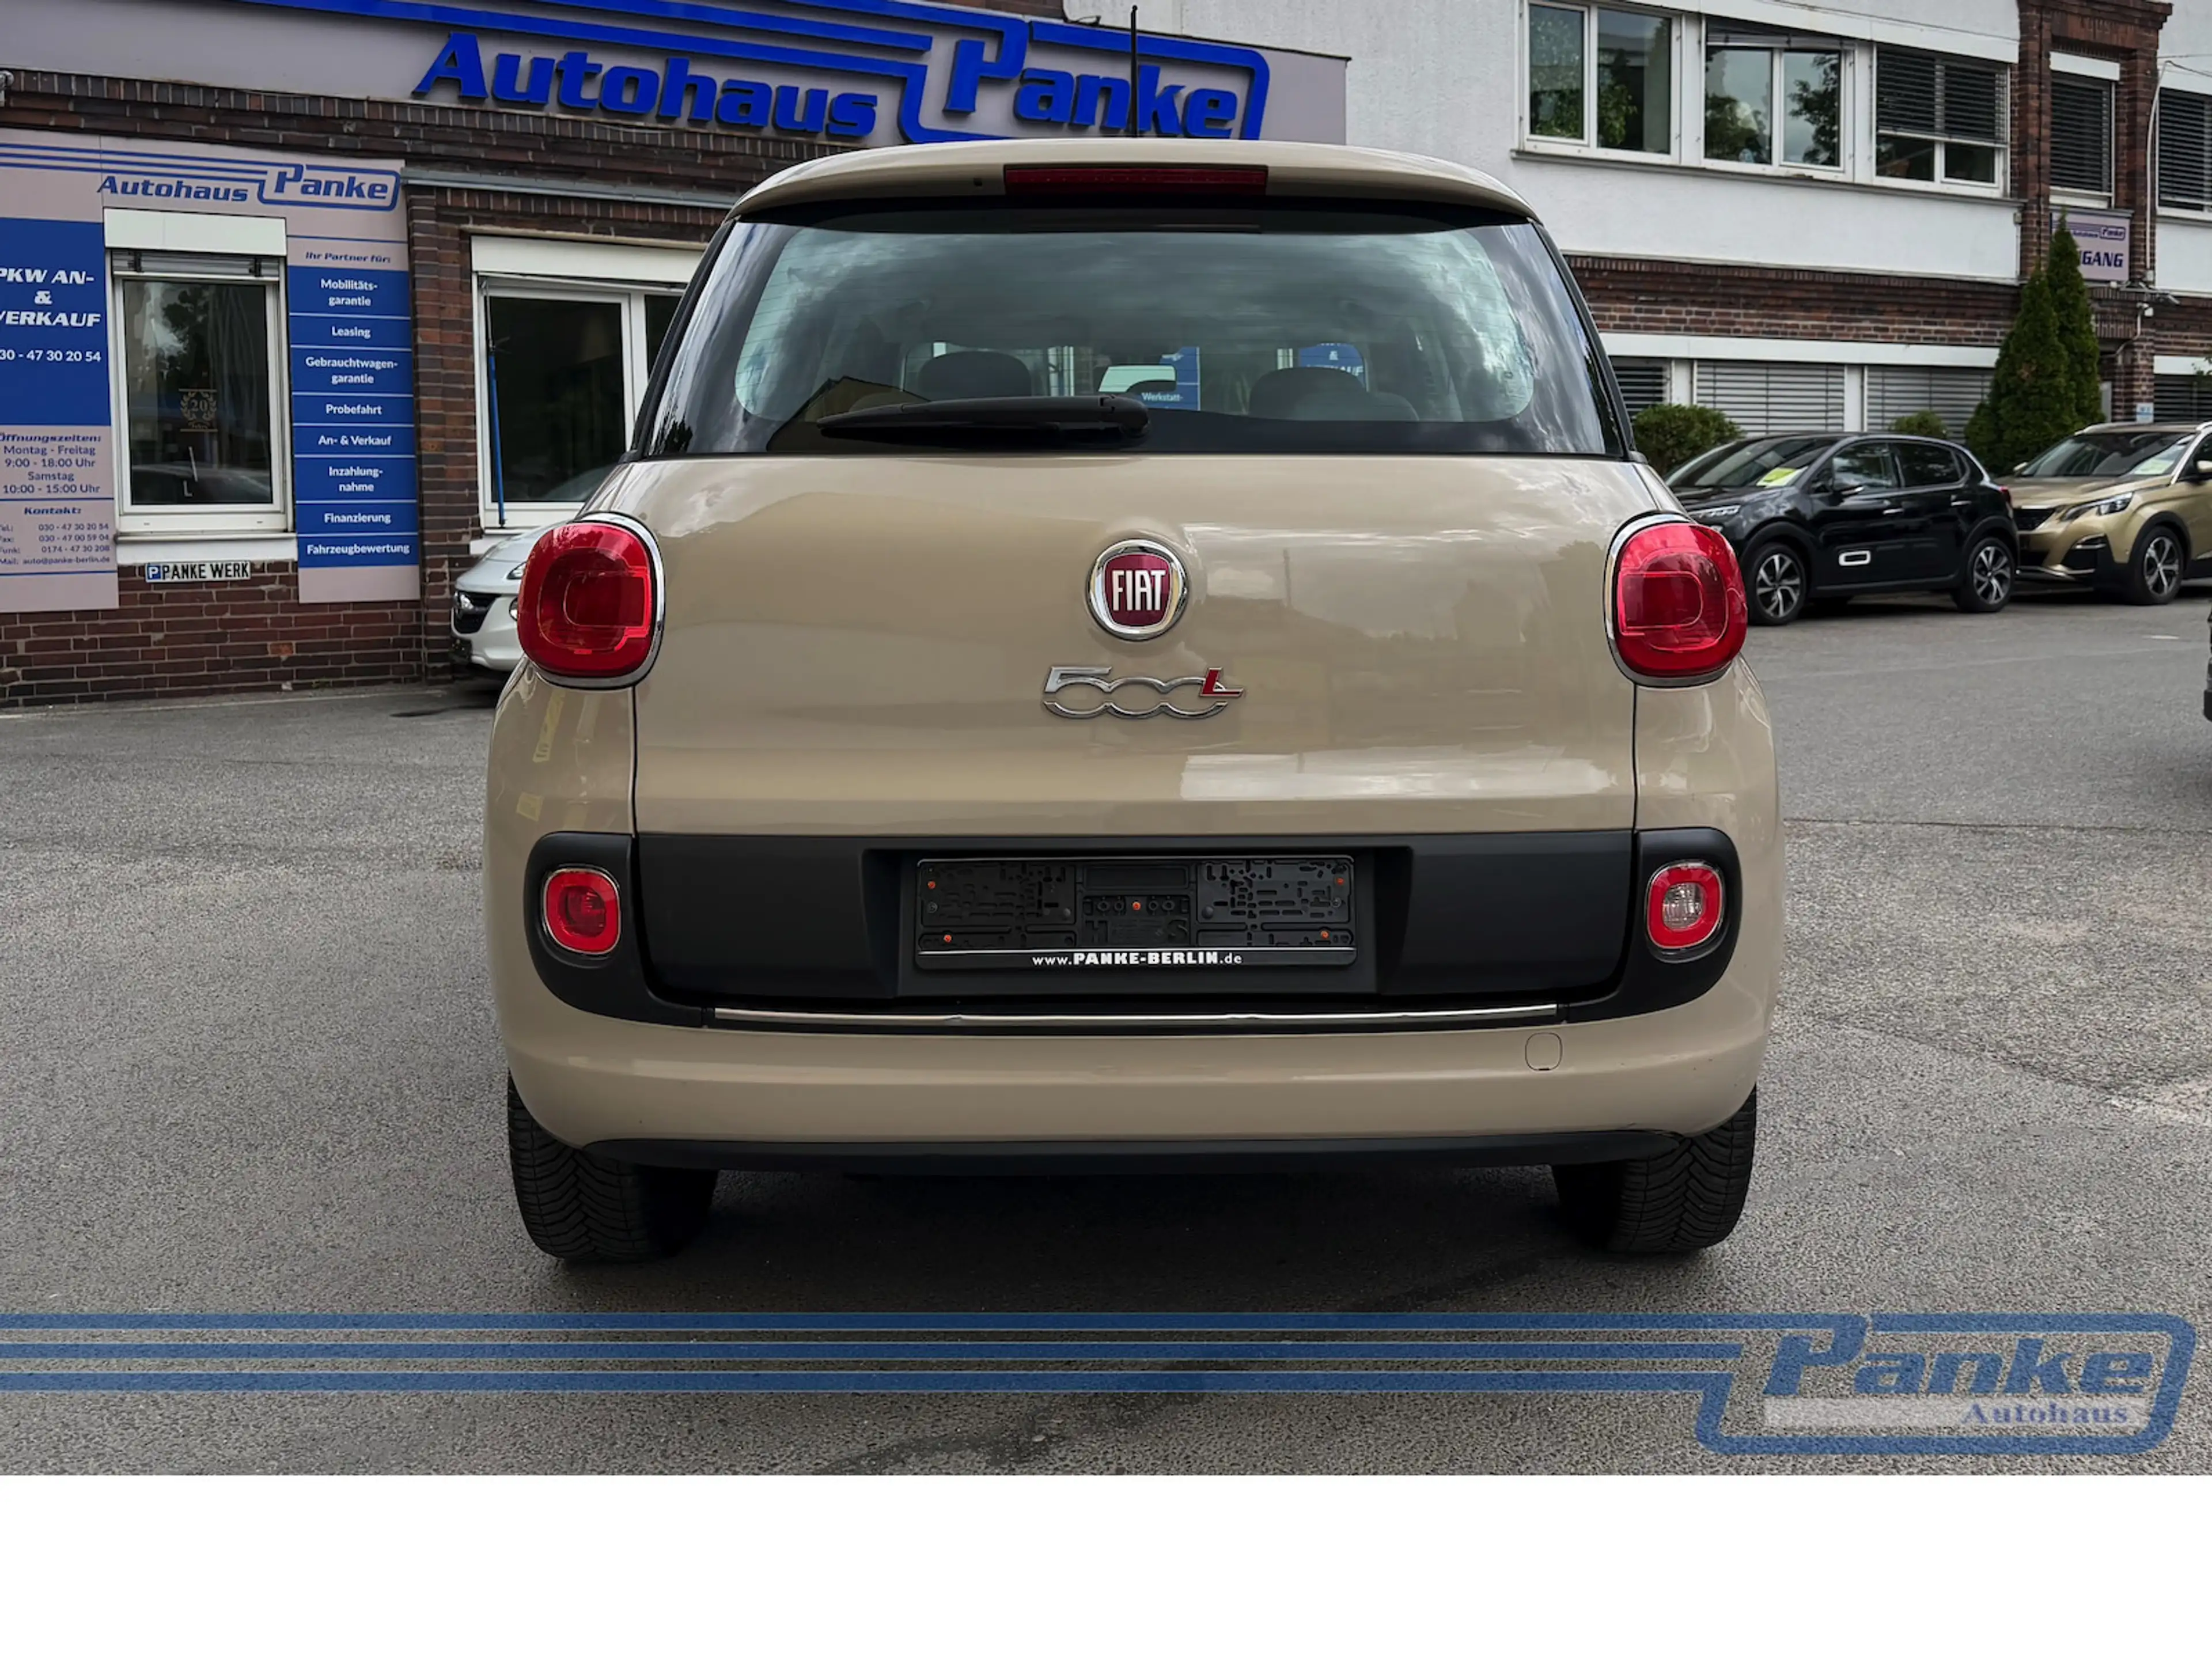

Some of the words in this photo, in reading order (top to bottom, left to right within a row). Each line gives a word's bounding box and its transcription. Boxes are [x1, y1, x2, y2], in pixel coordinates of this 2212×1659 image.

[412, 31, 879, 138] Autohaus
[941, 18, 1238, 138] Panke
[97, 175, 248, 202] Autohaus
[274, 164, 388, 200] Panke
[305, 251, 323, 259] Ihr
[324, 252, 367, 262] Partner
[2080, 251, 2123, 267] GANG
[51, 270, 94, 285] AN-
[320, 278, 378, 290] Mobilitäts-
[34, 290, 53, 305] &
[328, 296, 372, 306] garantie
[331, 325, 371, 339] Leasing
[26, 350, 43, 361] 47
[46, 350, 63, 361] 30
[66, 351, 82, 362] 20
[85, 351, 101, 362] 54
[305, 357, 399, 370] Gebrauchtwagen-
[331, 373, 374, 385] garantie
[325, 403, 382, 415] Probefahrt
[318, 435, 338, 445] An-
[340, 435, 349, 445] &
[350, 435, 392, 446] Verkauf
[3, 445, 47, 456] Montag
[58, 445, 96, 456] Freitag
[5, 458, 30, 468] 9:00
[41, 458, 73, 468] 18:00
[75, 458, 96, 467] Uhr
[28, 471, 74, 482] Samstag
[328, 466, 384, 478] Inzahlung-
[3, 484, 35, 494] 10:00
[46, 484, 77, 493] 15:00
[79, 484, 101, 493] Uhr
[339, 482, 374, 492] nahme
[24, 506, 82, 514] Kontakt:
[324, 513, 392, 524] Finanzierung
[306, 544, 410, 556] Fahrzeugbewertung
[162, 564, 206, 579] PANKE
[210, 562, 249, 575] WERK
[1112, 570, 1166, 611] FIAT
[1032, 952, 1243, 966] www.PANKE-BERLIN.de
